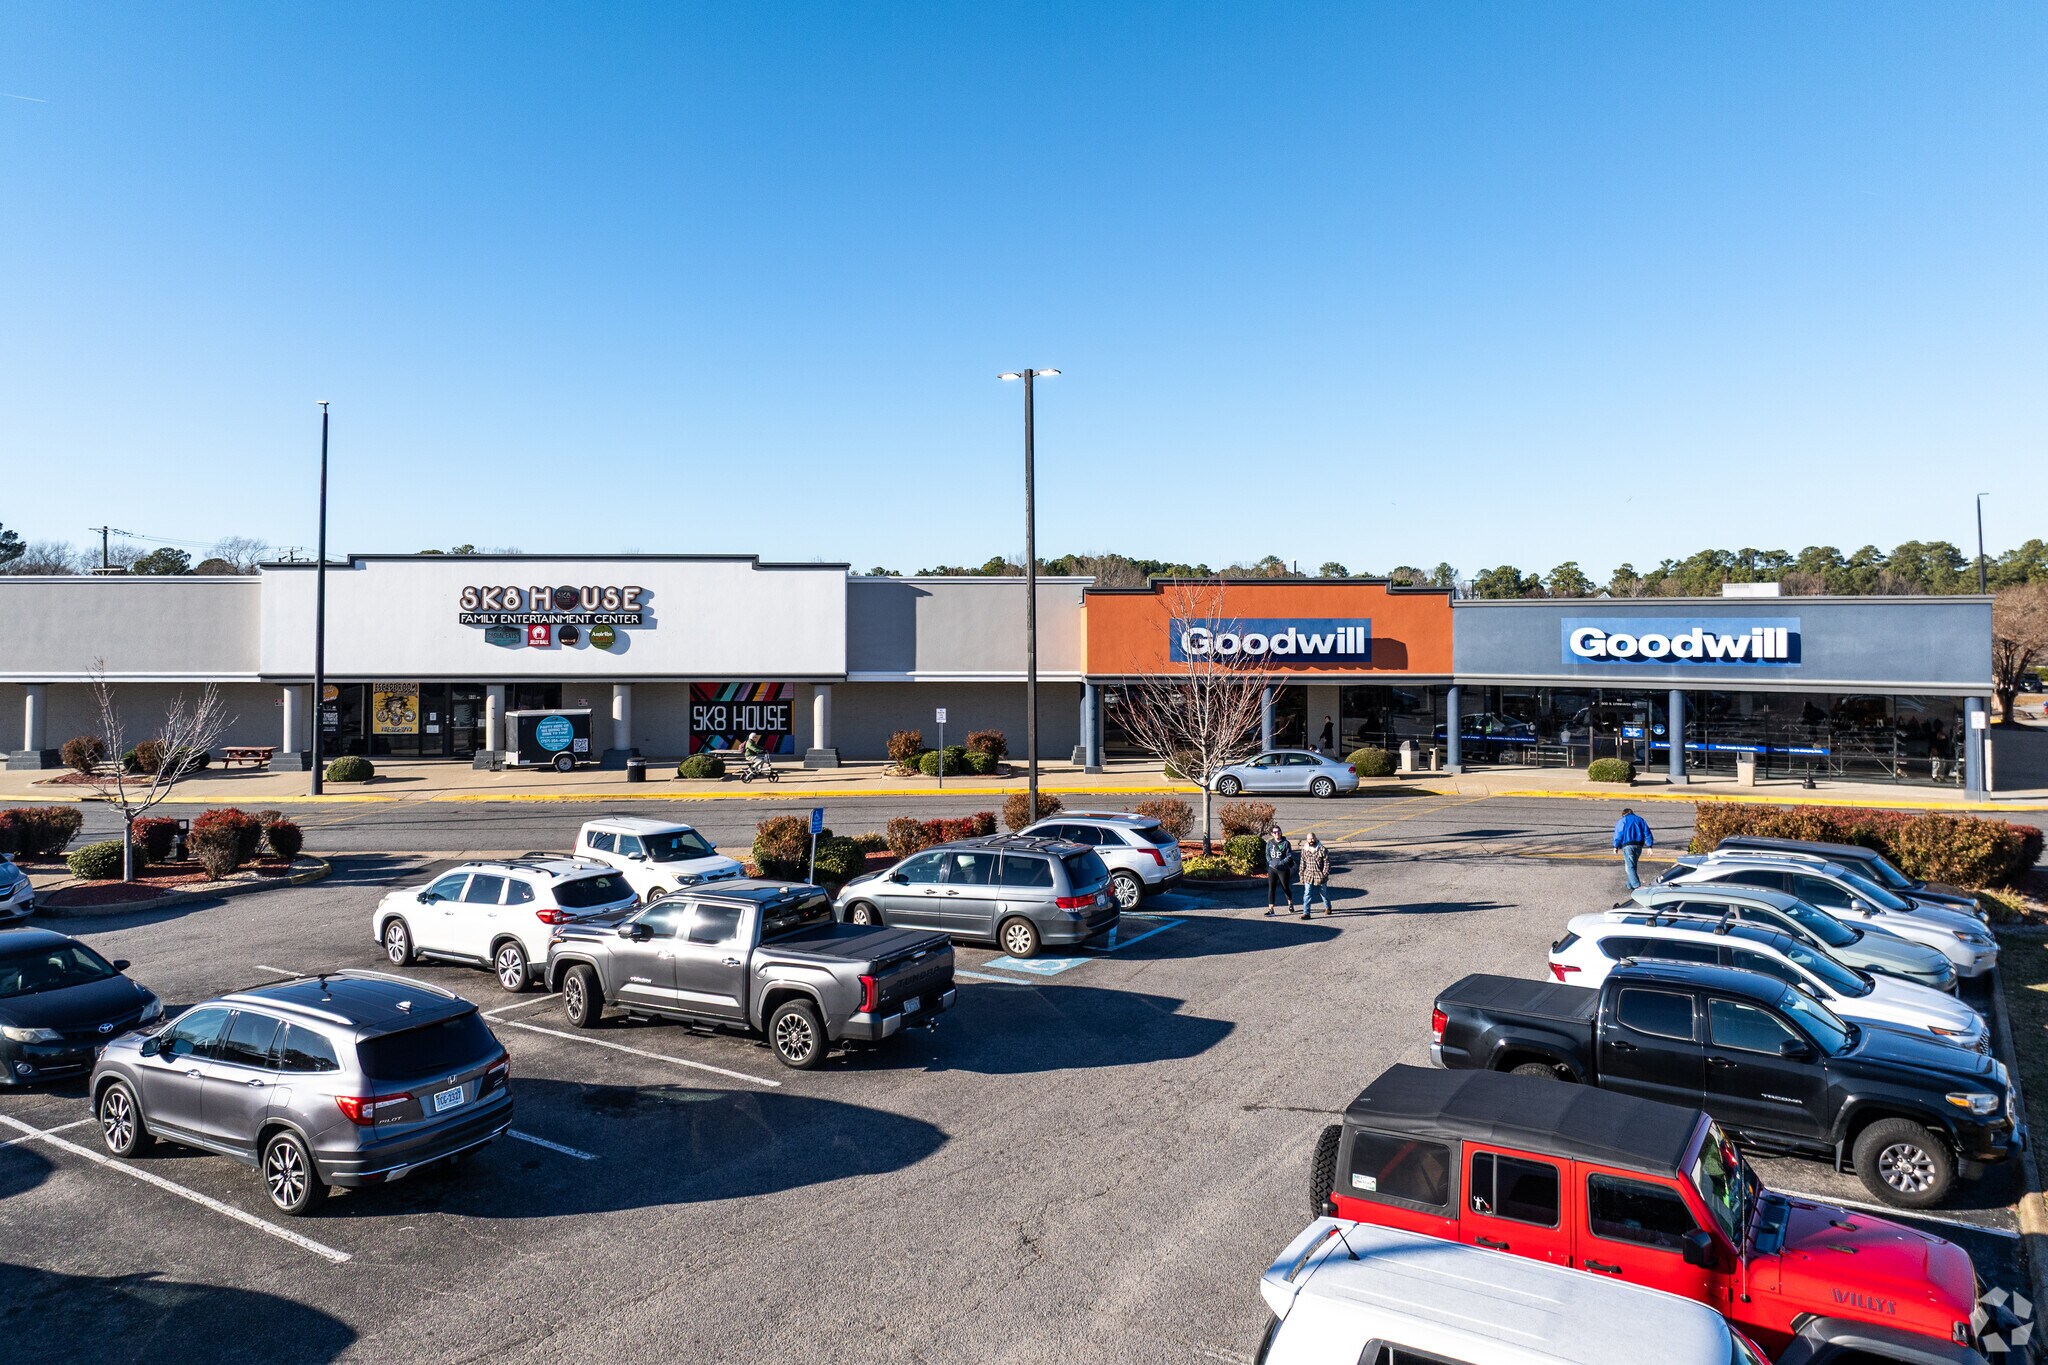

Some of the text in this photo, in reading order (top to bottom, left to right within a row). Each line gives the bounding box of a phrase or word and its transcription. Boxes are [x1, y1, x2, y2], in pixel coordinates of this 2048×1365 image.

[460, 585, 522, 612] SK8
[461, 614, 639, 624] FAMILY ENTERTAINMENT CENTER
[1180, 626, 1365, 656] Goodwill
[1569, 627, 1788, 659] Goodwill
[693, 706, 787, 731] SK8 HOUSE
[379, 1115, 403, 1124] PILOT
[1831, 1288, 1896, 1315] WILLYS
